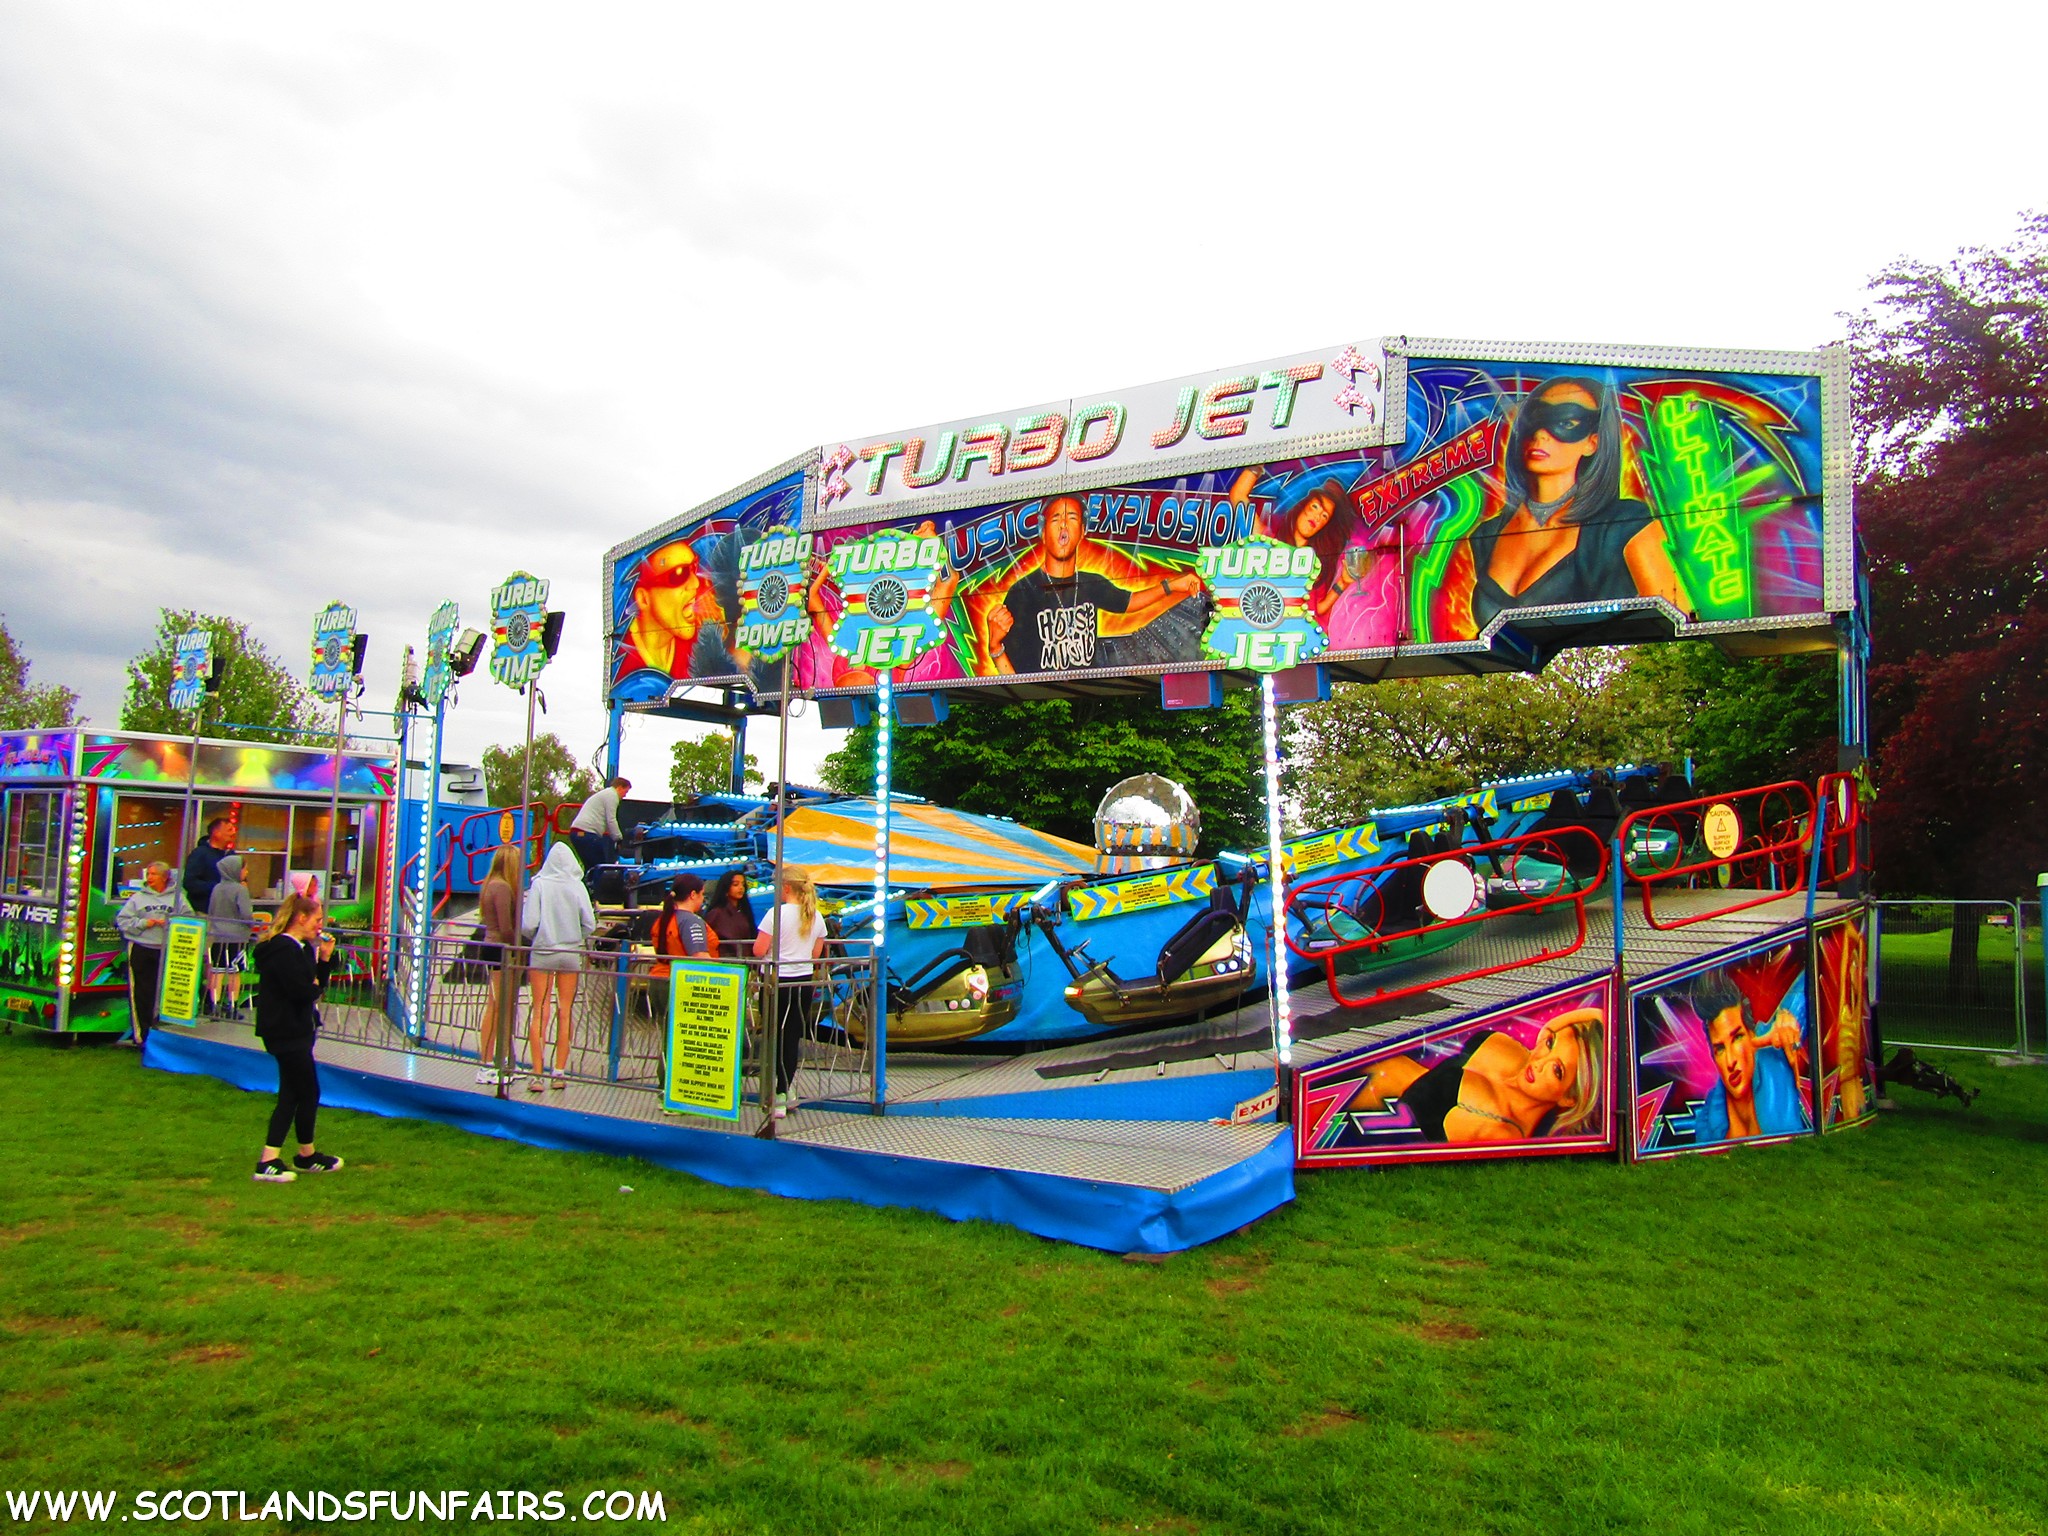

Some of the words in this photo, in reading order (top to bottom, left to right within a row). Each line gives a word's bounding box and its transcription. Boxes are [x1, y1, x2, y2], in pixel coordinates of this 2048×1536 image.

[859, 401, 1127, 496] TURBO
[1151, 361, 1325, 451] JET
[1359, 430, 1487, 528] EXTREME
[1661, 392, 1744, 606] ULTIMATE
[739, 534, 812, 570] TURBO
[940, 500, 1042, 581] USIC
[1086, 493, 1256, 547] EXPLOSION
[833, 538, 941, 574] TURBO
[1202, 547, 1314, 577] TURBO
[491, 578, 550, 610] TURBO
[314, 608, 357, 633] TURBO
[735, 619, 811, 648] POWER
[176, 631, 213, 652] TURBO
[850, 626, 923, 665] JET
[1228, 633, 1305, 668] JET
[309, 671, 353, 692] POWER
[492, 653, 543, 685] TIME
[169, 687, 204, 710] TIME
[1, 902, 24, 920] PAY
[25, 905, 59, 924] HERE
[1238, 1095, 1275, 1117] EXIT
